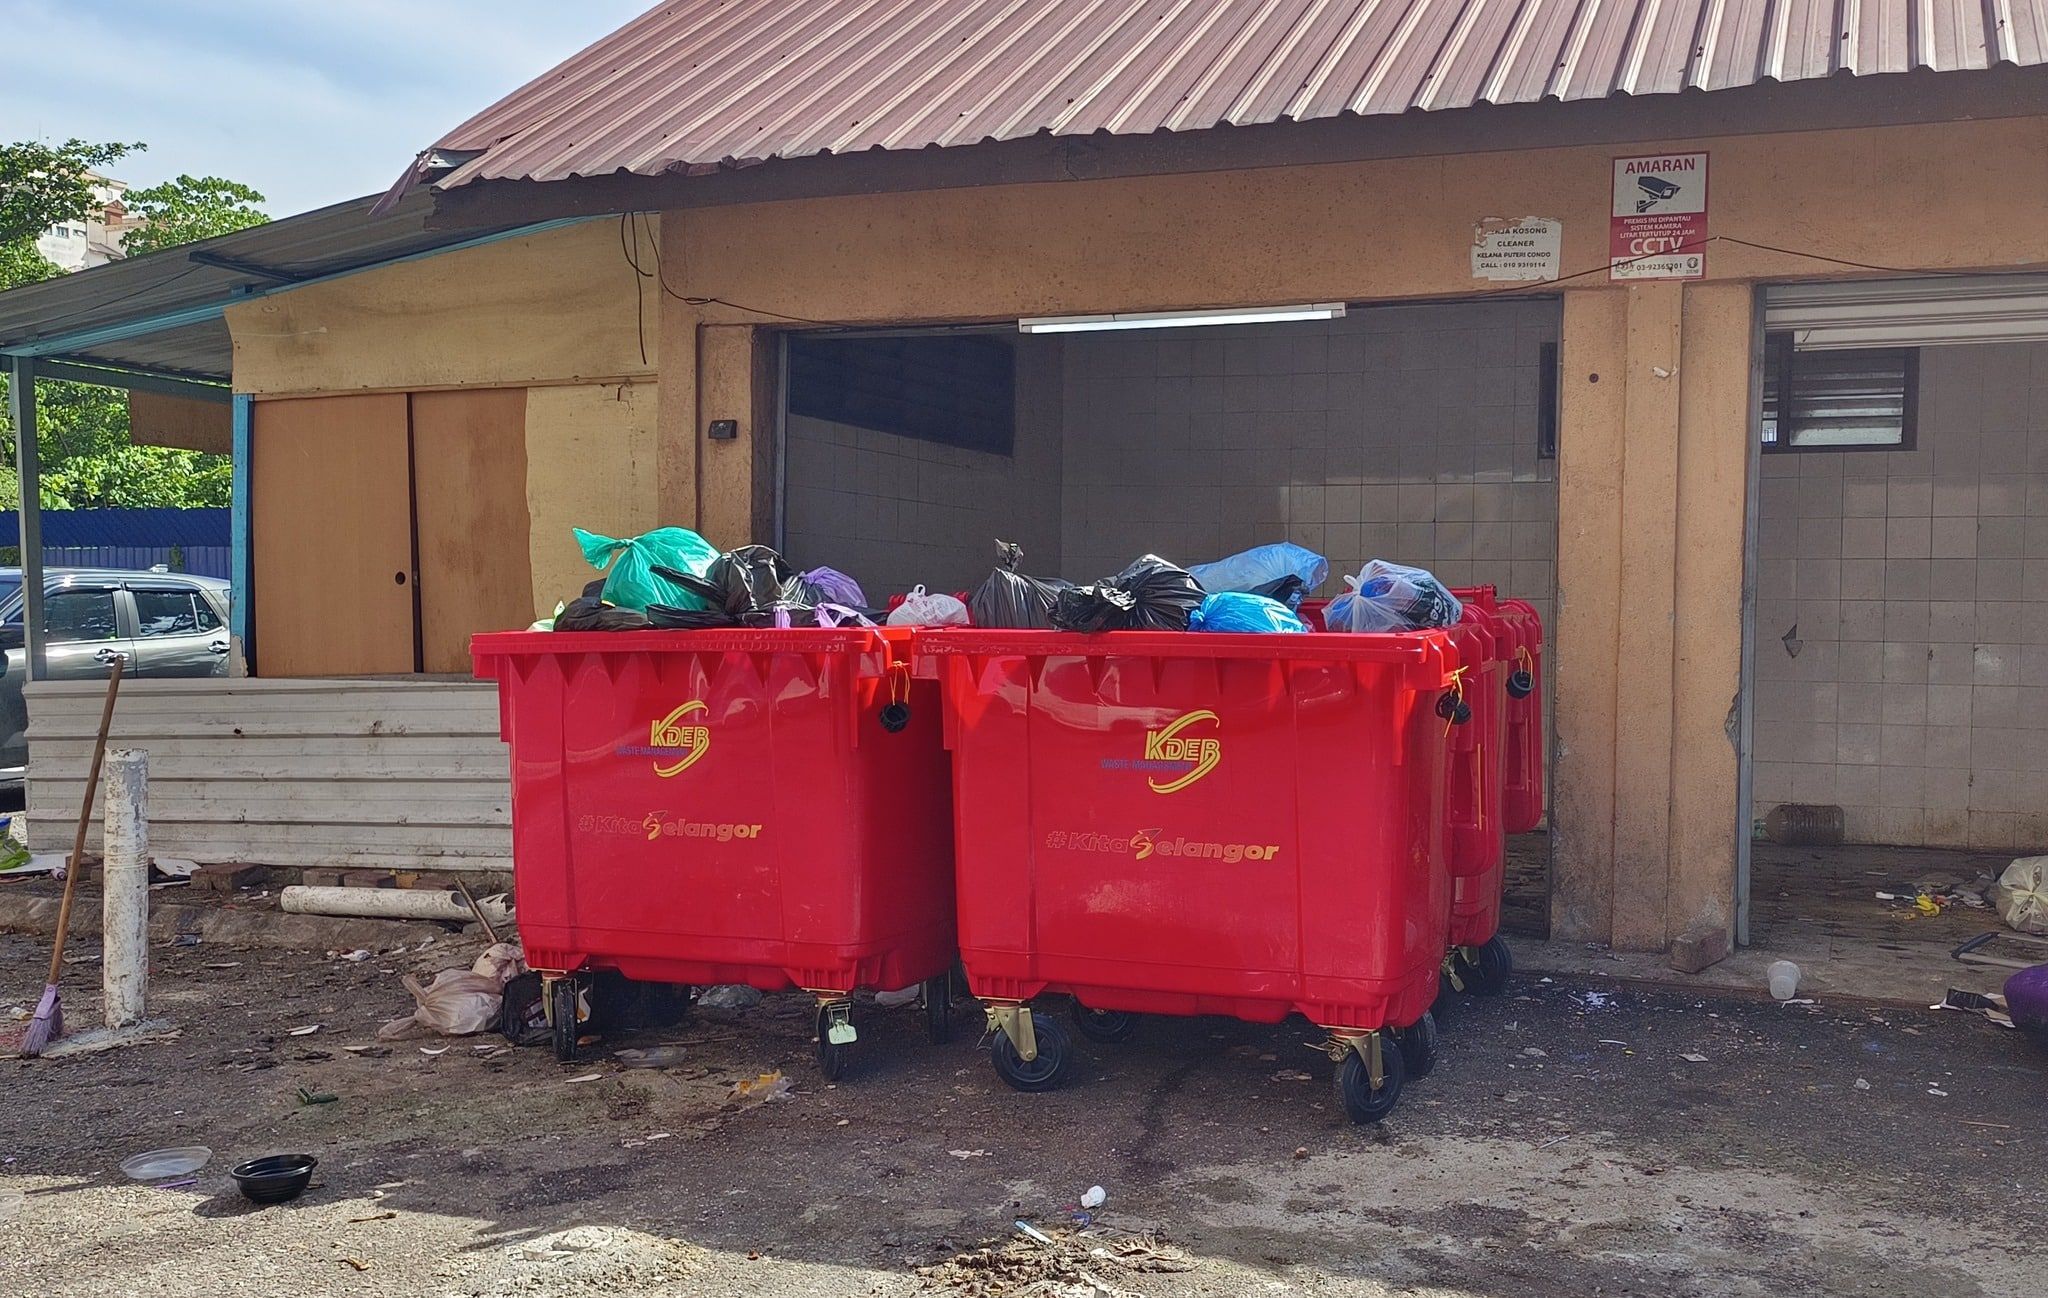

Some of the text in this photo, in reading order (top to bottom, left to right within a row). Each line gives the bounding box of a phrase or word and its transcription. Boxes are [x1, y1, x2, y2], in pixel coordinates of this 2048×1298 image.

[1625, 158, 1695, 174] AMARAN
[1630, 236, 1684, 255] CCTV
[650, 719, 711, 751] KDEB
[1144, 730, 1221, 764] KDEB
